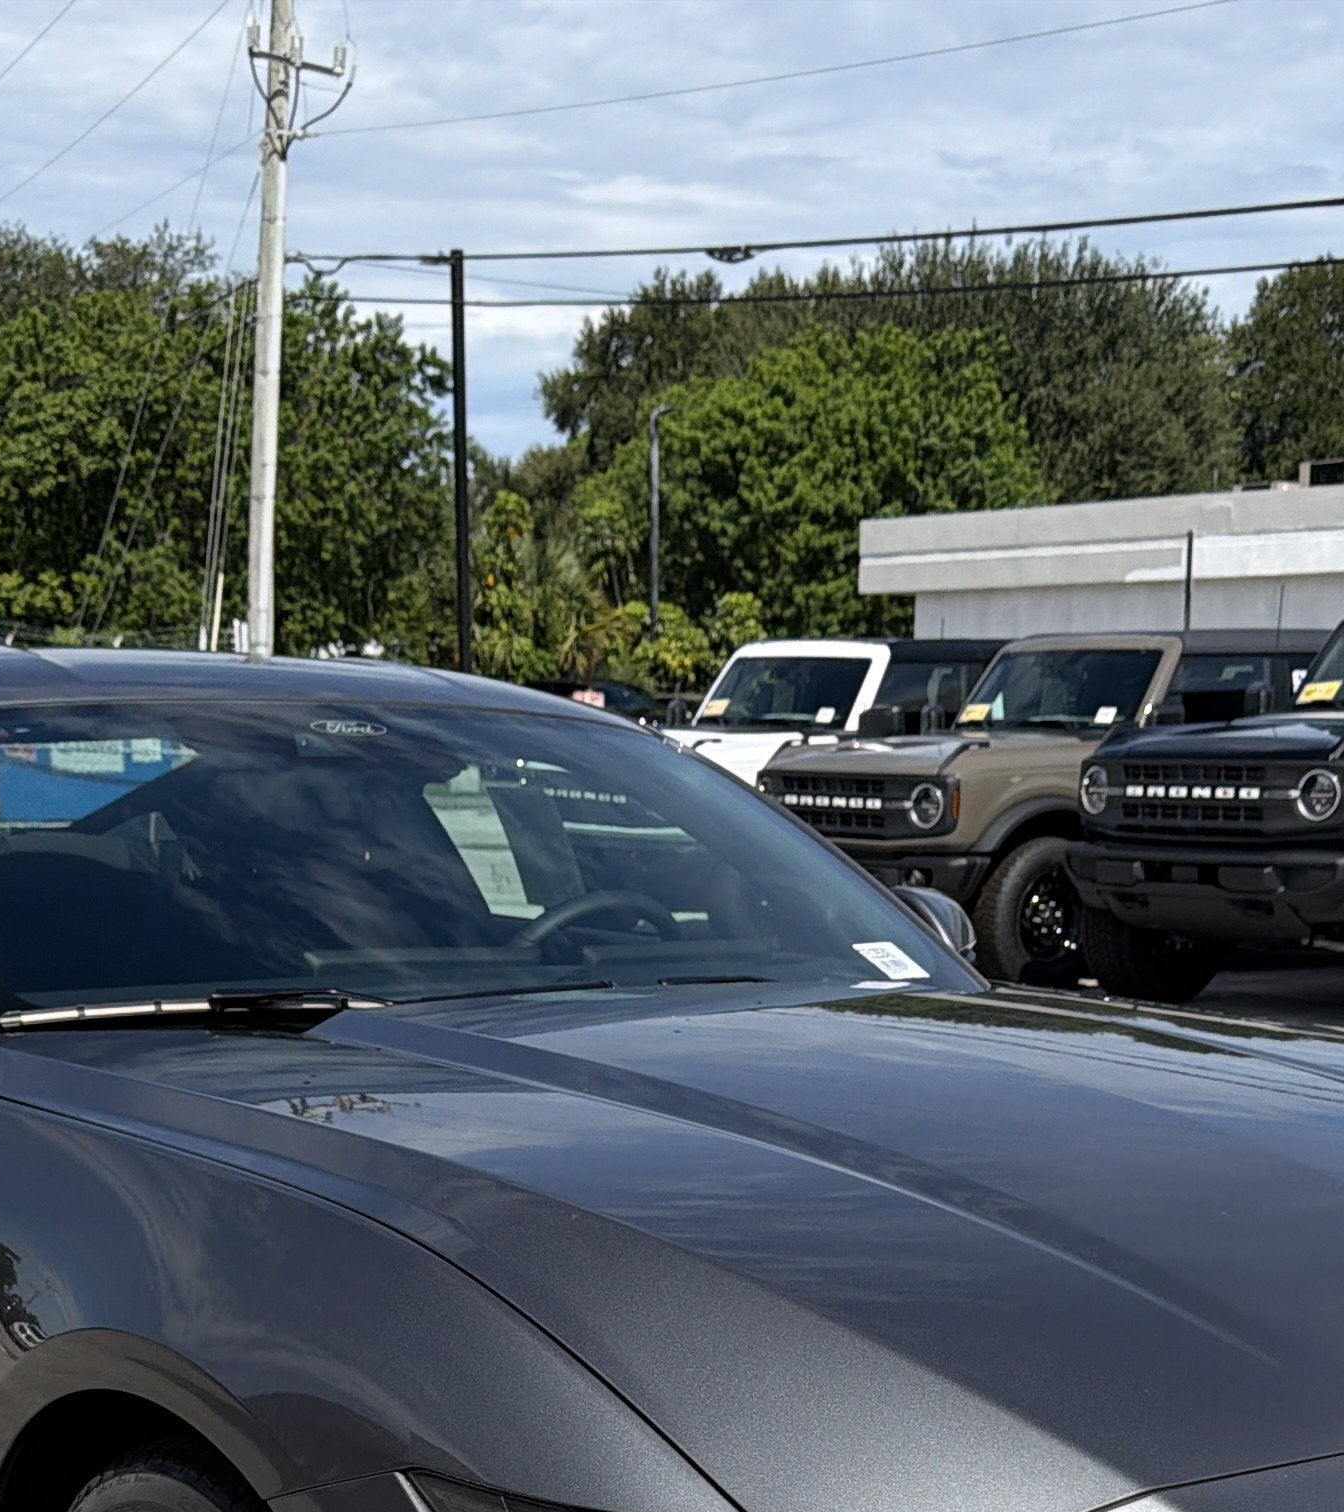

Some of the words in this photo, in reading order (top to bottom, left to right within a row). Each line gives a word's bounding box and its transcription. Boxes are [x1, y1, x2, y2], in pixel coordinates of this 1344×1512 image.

[323, 720, 377, 735] Ford
[1125, 784, 1260, 800] BRONCO
[784, 794, 882, 810] BRONCO
